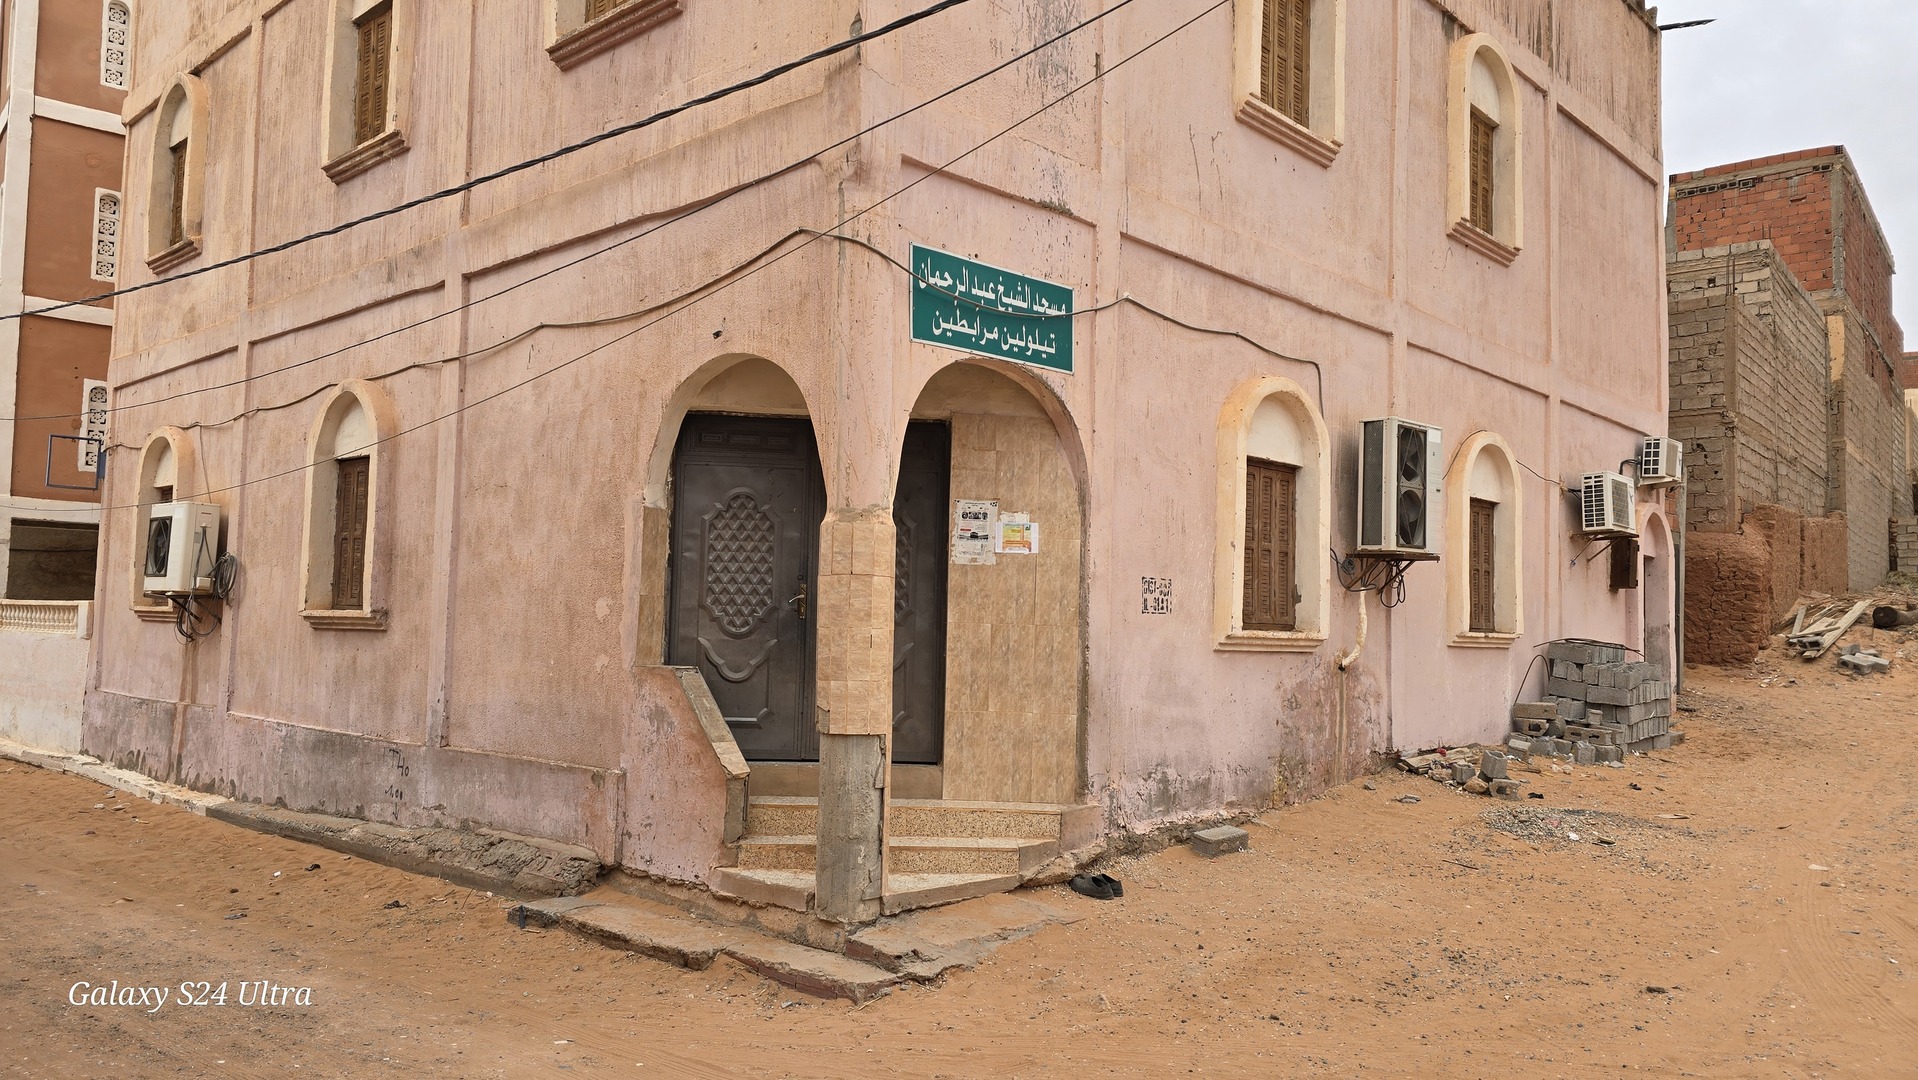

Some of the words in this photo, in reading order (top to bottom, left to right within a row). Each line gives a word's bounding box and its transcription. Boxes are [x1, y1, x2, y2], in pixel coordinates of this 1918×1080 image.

[918, 256, 969, 305] الرحمان
[971, 275, 996, 306] عبد
[997, 276, 1031, 313] الشيخ
[1032, 291, 1066, 321] مسجد
[932, 307, 999, 345] مرابطين
